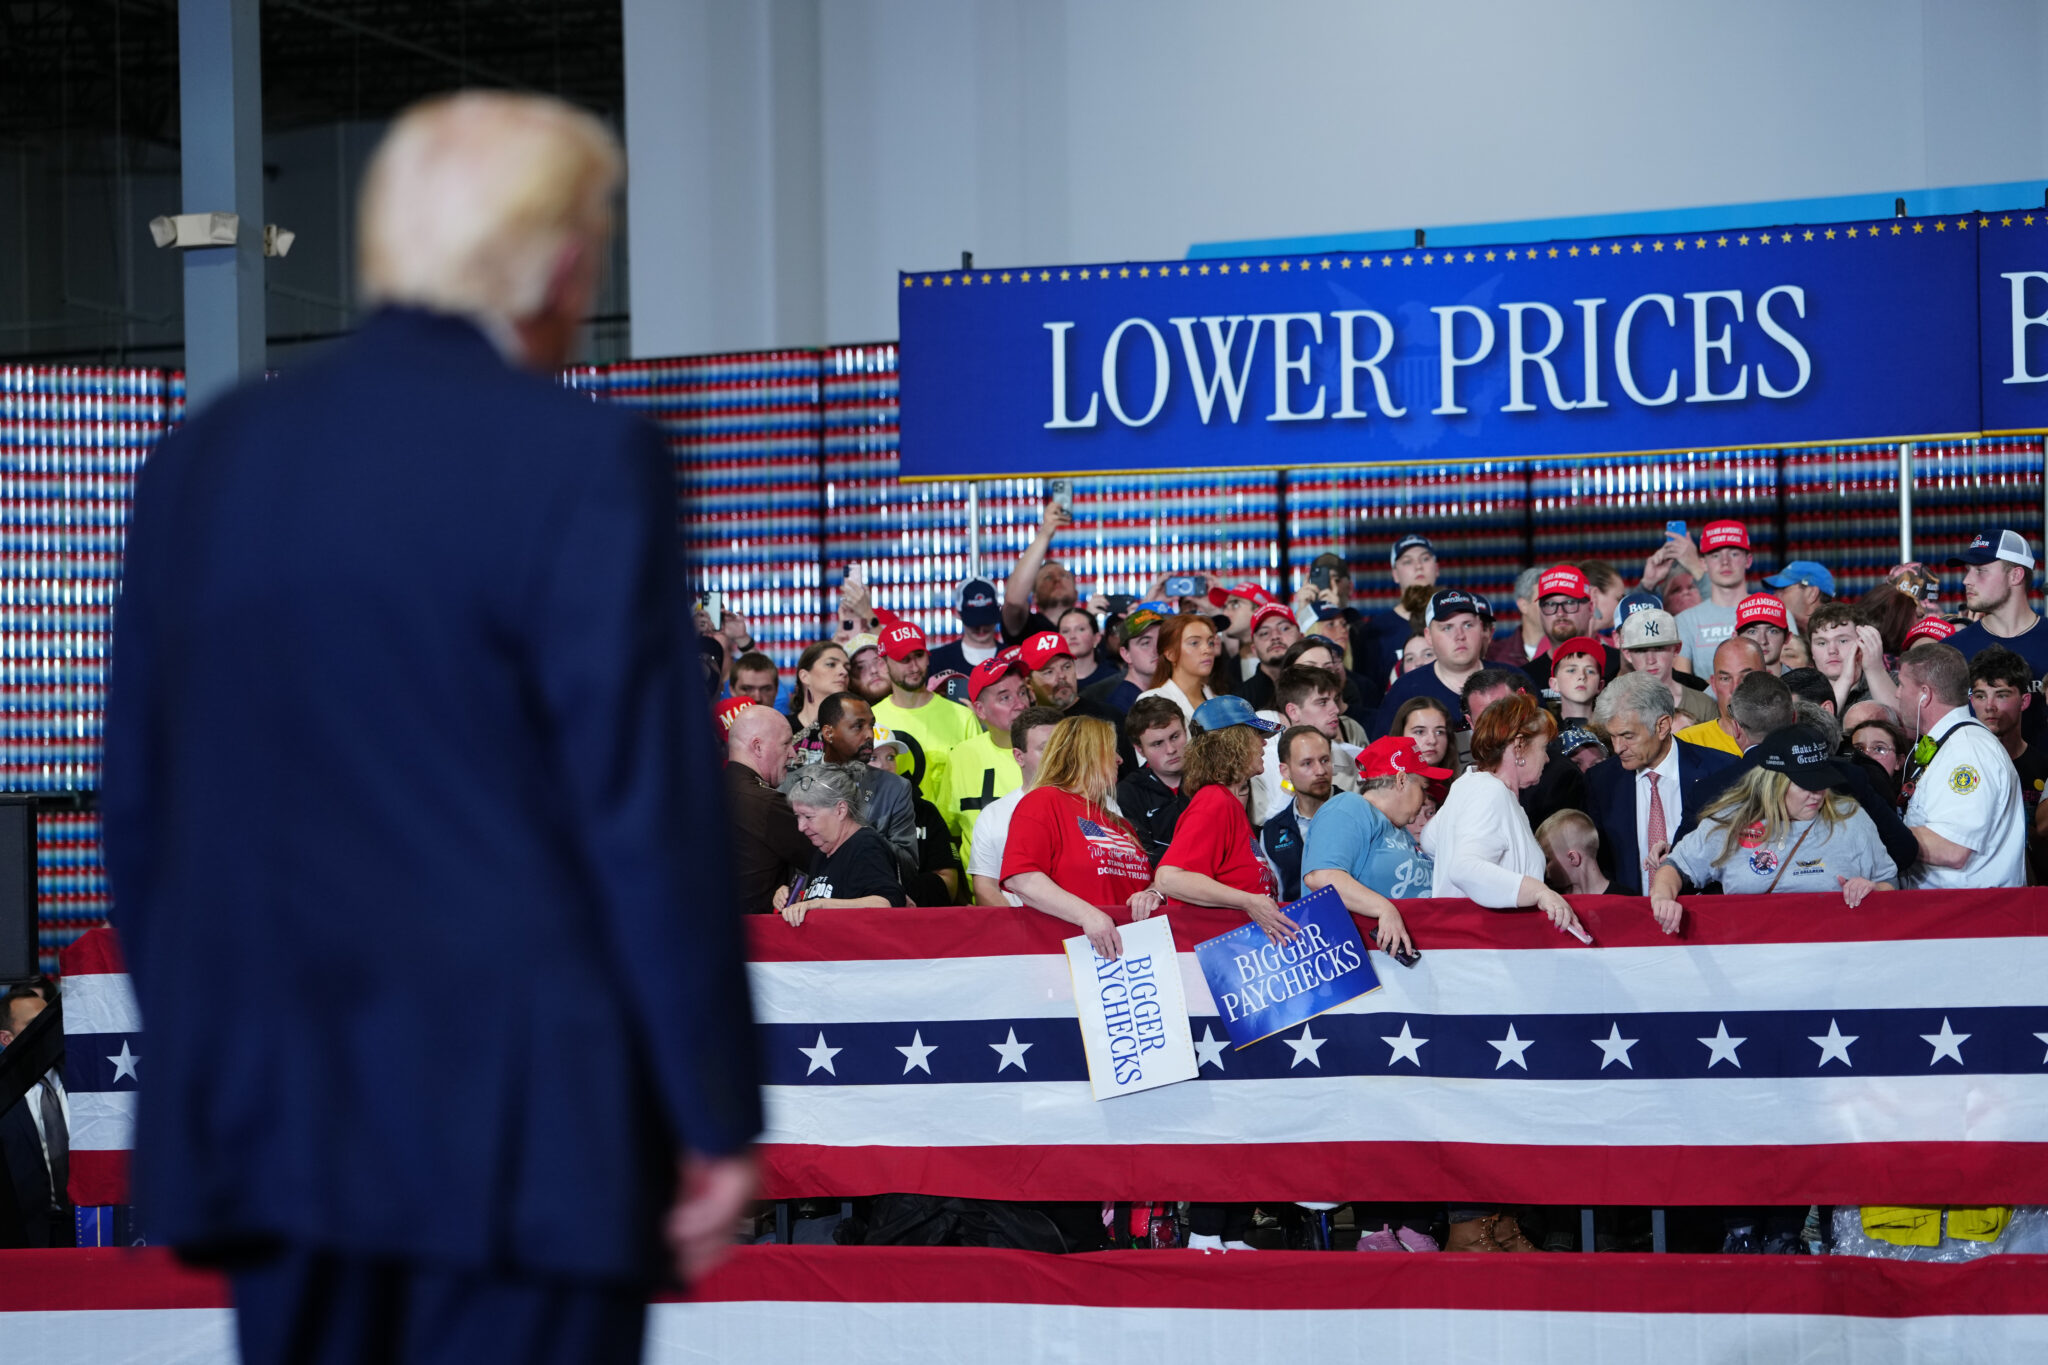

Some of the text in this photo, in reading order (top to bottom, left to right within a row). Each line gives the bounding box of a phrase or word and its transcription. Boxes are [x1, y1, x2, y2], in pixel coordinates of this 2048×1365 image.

[1043, 284, 1813, 430] LOWER PRICES
[1739, 598, 1784, 610] MAKE AMERICA
[1742, 607, 1782, 618] GREAT AGAIN
[891, 626, 921, 642] USA
[1037, 635, 1059, 651] 47
[1792, 745, 1812, 755] Make
[1797, 752, 1819, 765] Great
[1097, 867, 1127, 877] DONALD
[1107, 859, 1142, 871] STAND WITH
[1234, 923, 1330, 983] BIGGER
[1220, 940, 1361, 1023] PAYCHECKS
[1125, 953, 1167, 1055] BIGGER
[1091, 942, 1143, 1086] AYCHECKS
